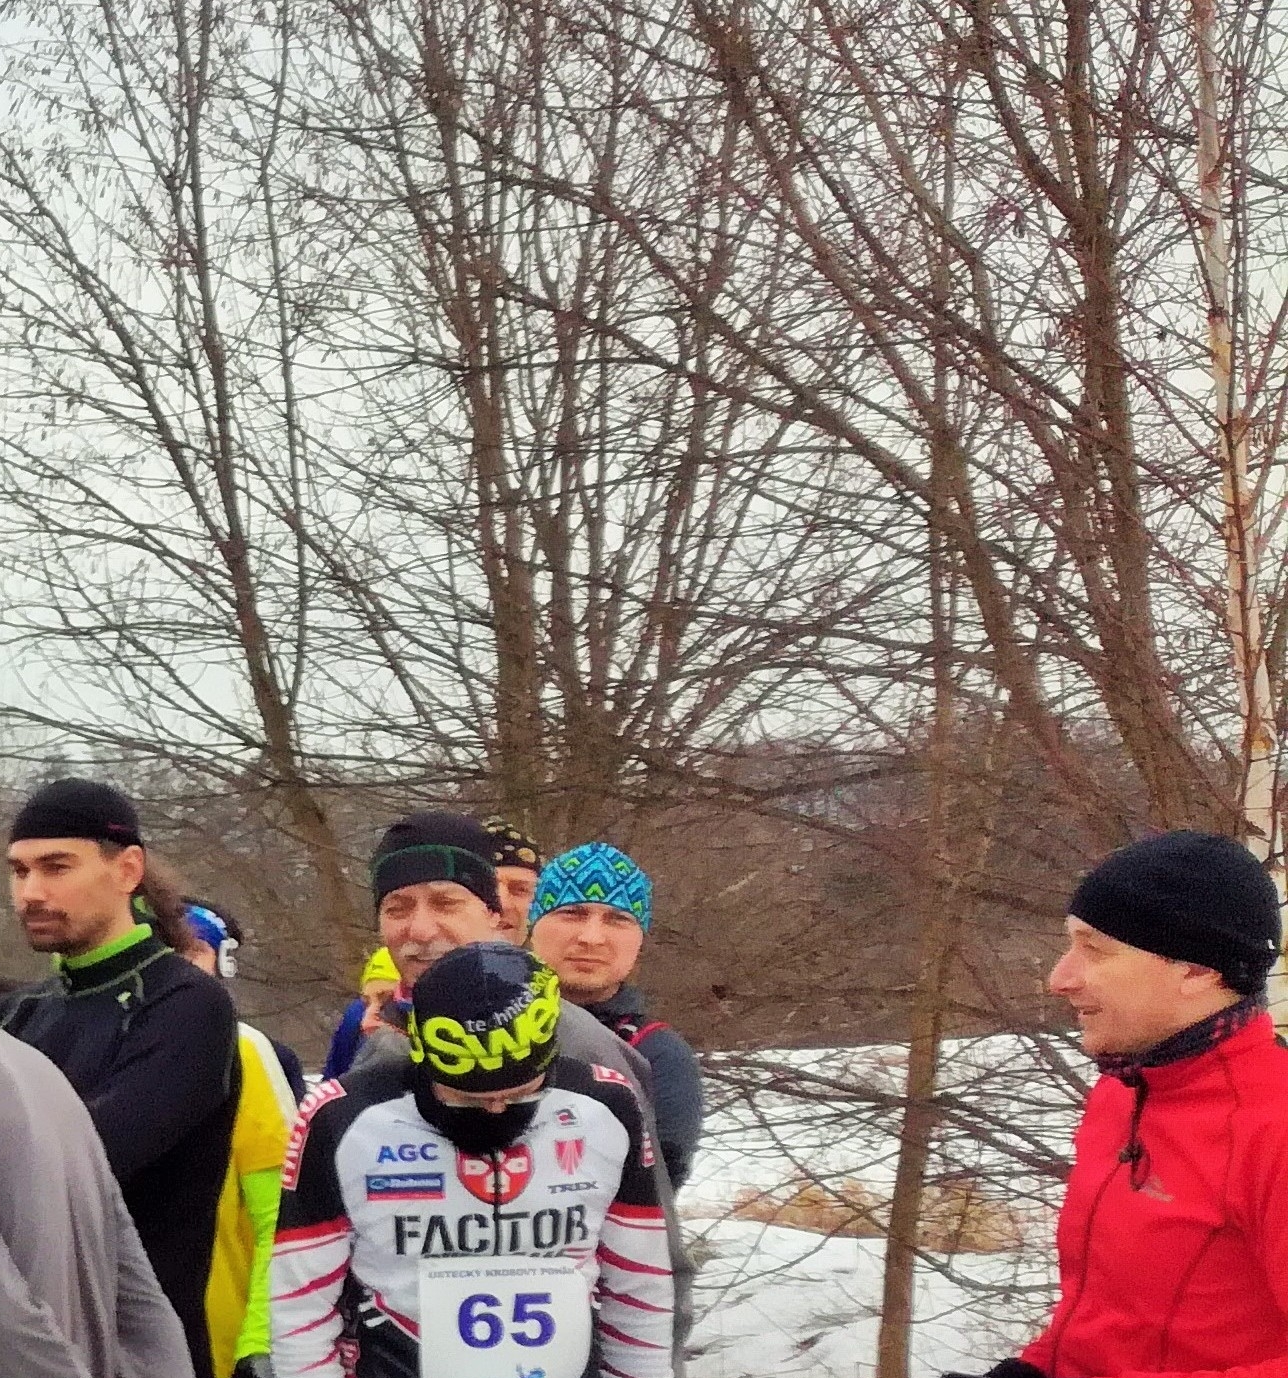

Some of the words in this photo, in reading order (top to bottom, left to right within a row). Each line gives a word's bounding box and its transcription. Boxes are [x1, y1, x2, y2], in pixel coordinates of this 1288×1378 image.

[377, 1142, 440, 1165] AGC
[393, 1203, 589, 1257] FACTOR
[457, 1293, 557, 1349] 65
